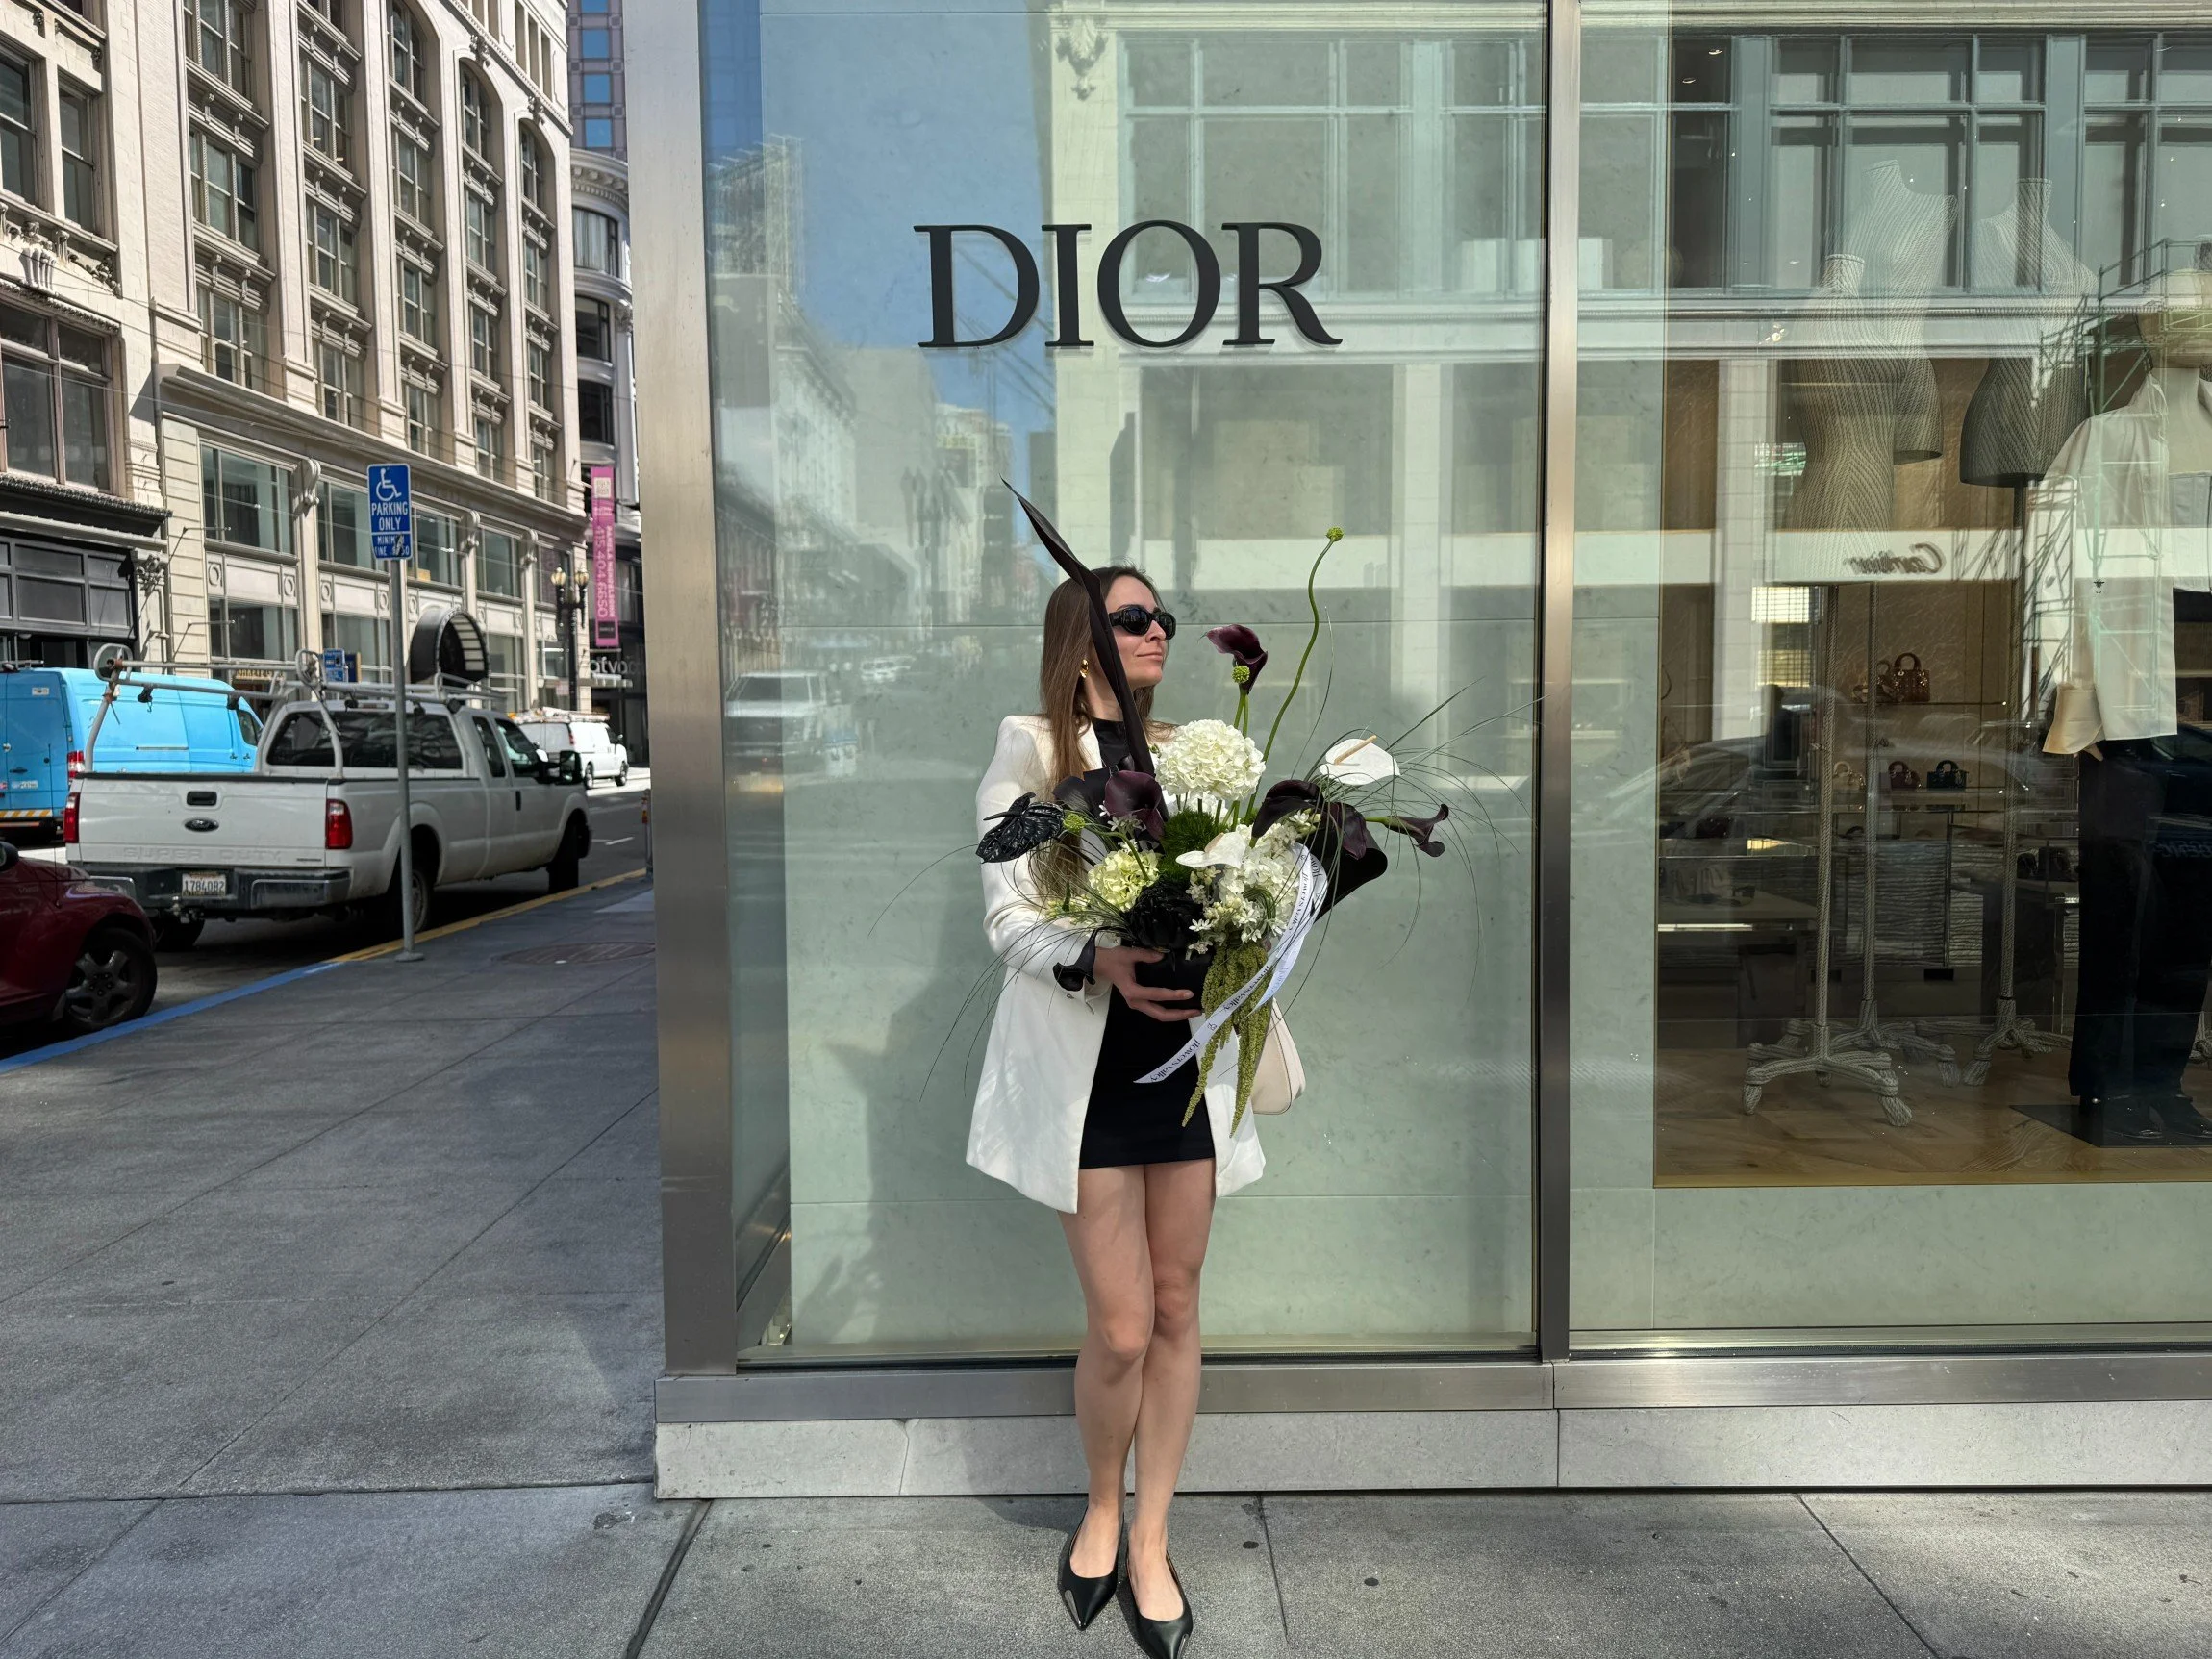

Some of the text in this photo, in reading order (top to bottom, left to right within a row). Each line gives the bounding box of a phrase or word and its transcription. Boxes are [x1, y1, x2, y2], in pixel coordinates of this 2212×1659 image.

[913, 219, 1344, 348] DIOR
[371, 501, 409, 516] PARKING
[378, 516, 402, 531] ONLY
[123, 846, 281, 863] SUPER DUTY
